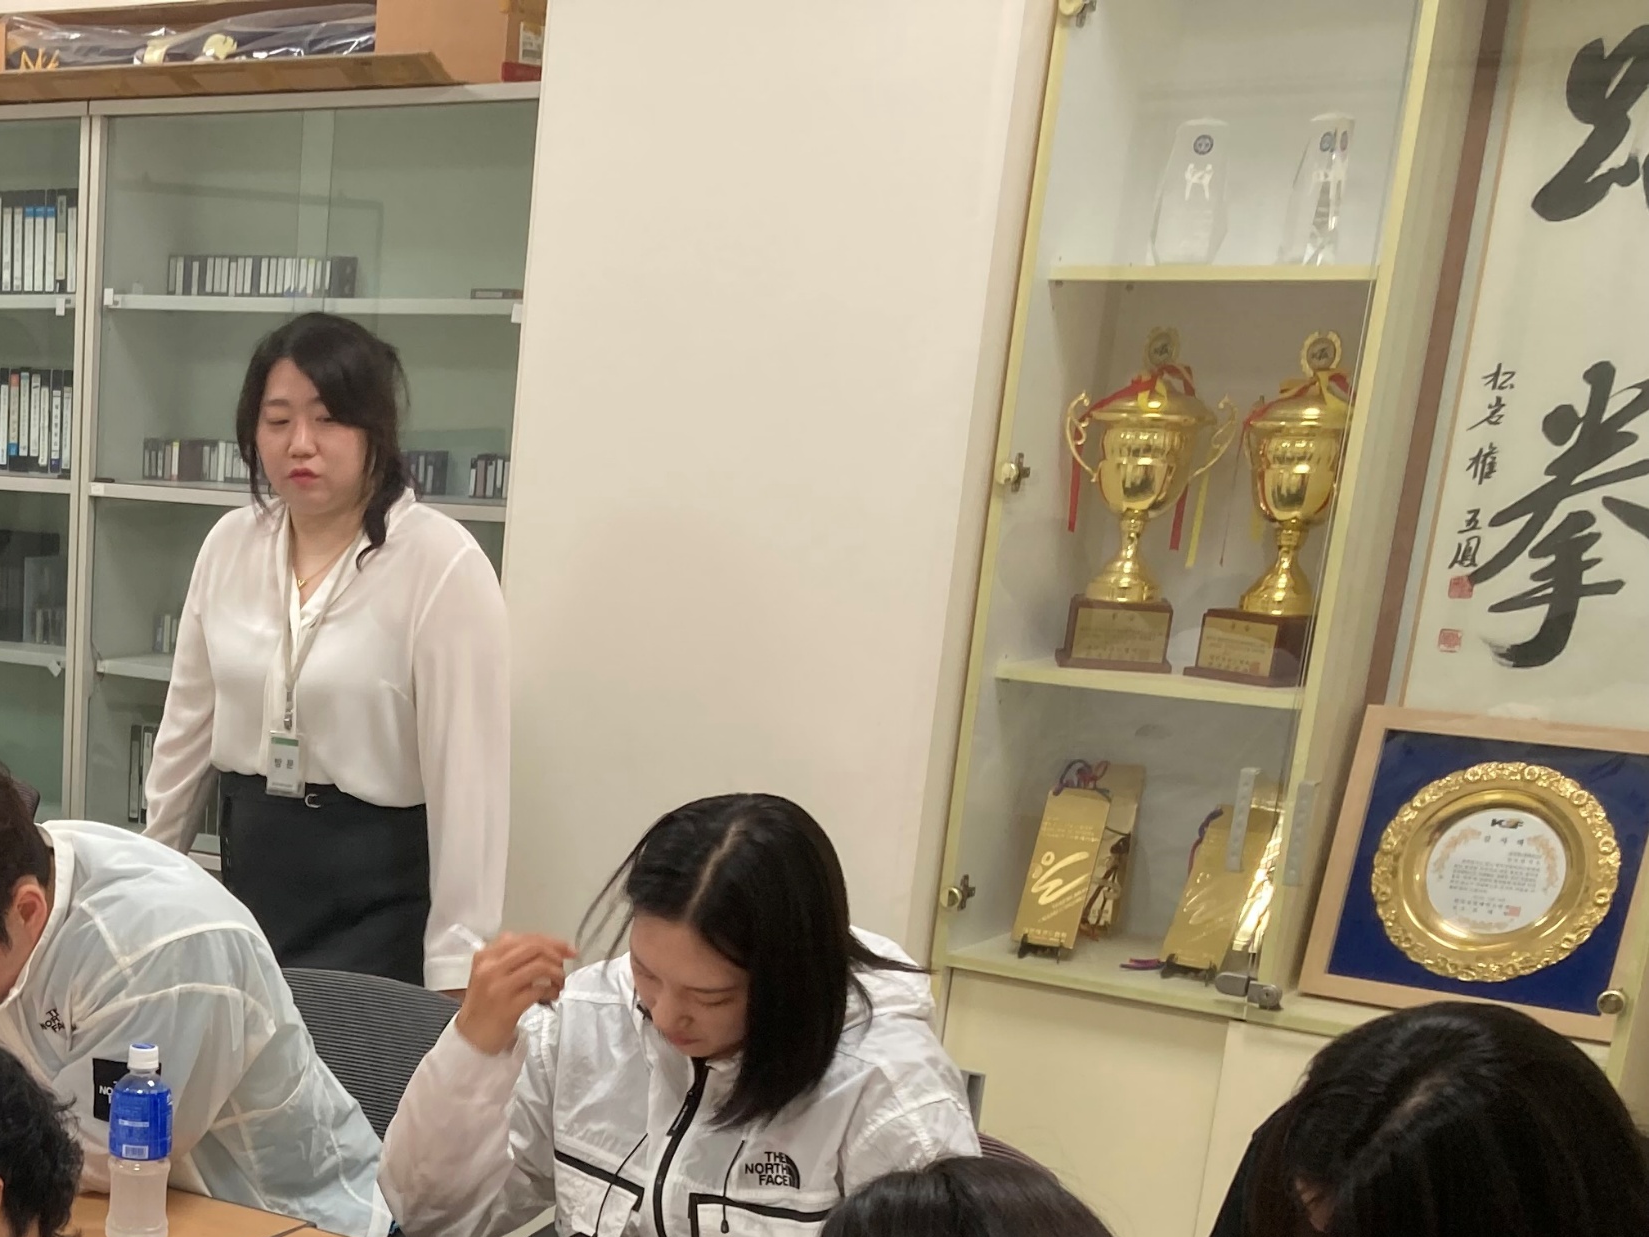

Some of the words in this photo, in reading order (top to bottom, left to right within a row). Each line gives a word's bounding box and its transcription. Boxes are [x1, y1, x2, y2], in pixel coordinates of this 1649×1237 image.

[764, 1151, 787, 1163] THE
[744, 1162, 788, 1175] NORTH
[758, 1174, 789, 1187] FACE
